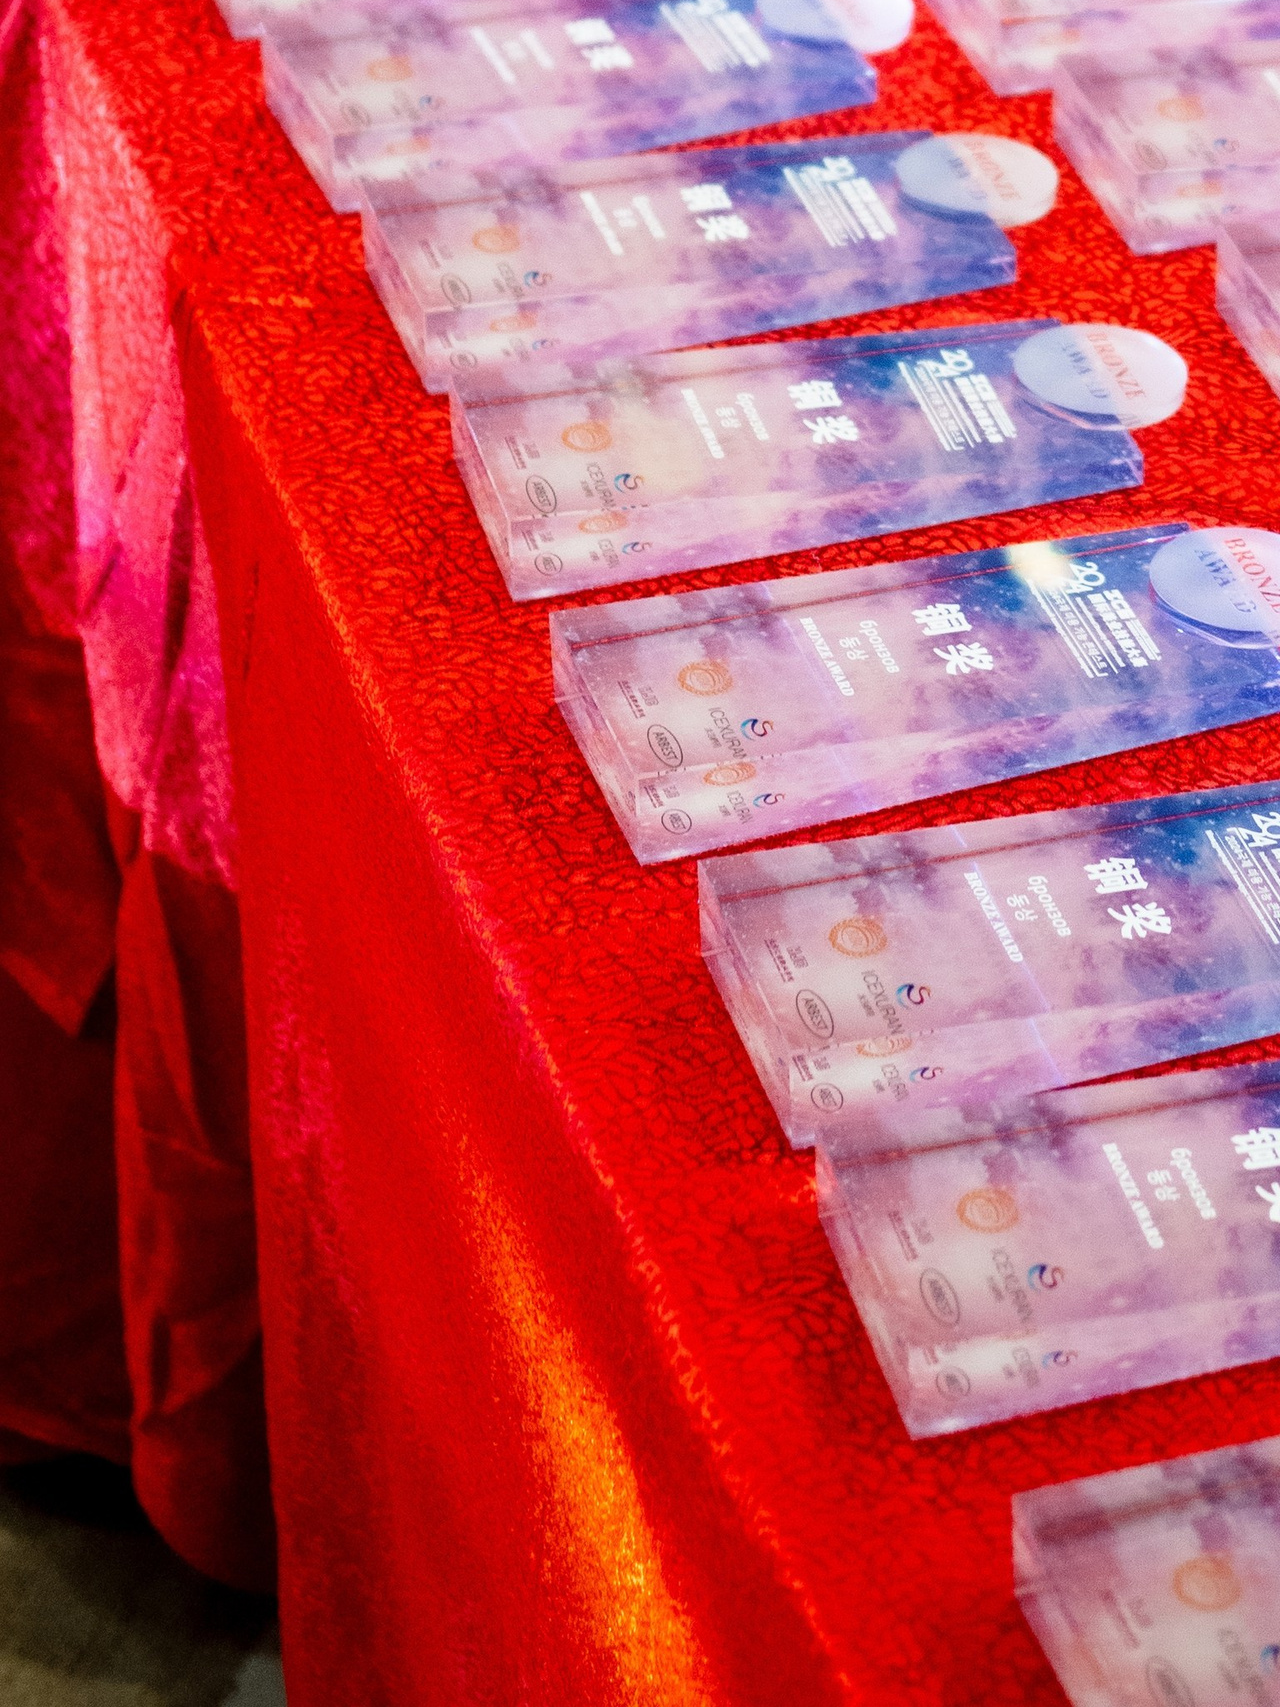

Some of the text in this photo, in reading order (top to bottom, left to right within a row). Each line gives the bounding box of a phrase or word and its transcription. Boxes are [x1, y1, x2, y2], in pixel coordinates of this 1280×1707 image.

[1194, 549, 1257, 613] AWAD
[801, 617, 854, 696] BRONZE AWARD
[839, 637, 869, 660] 동상
[912, 603, 993, 675] 铜奖
[964, 872, 1023, 963] BRONZE AWARD
[1006, 894, 1038, 922] 동상
[1027, 876, 1071, 937] бронзов
[1084, 857, 1172, 939] 铜奖
